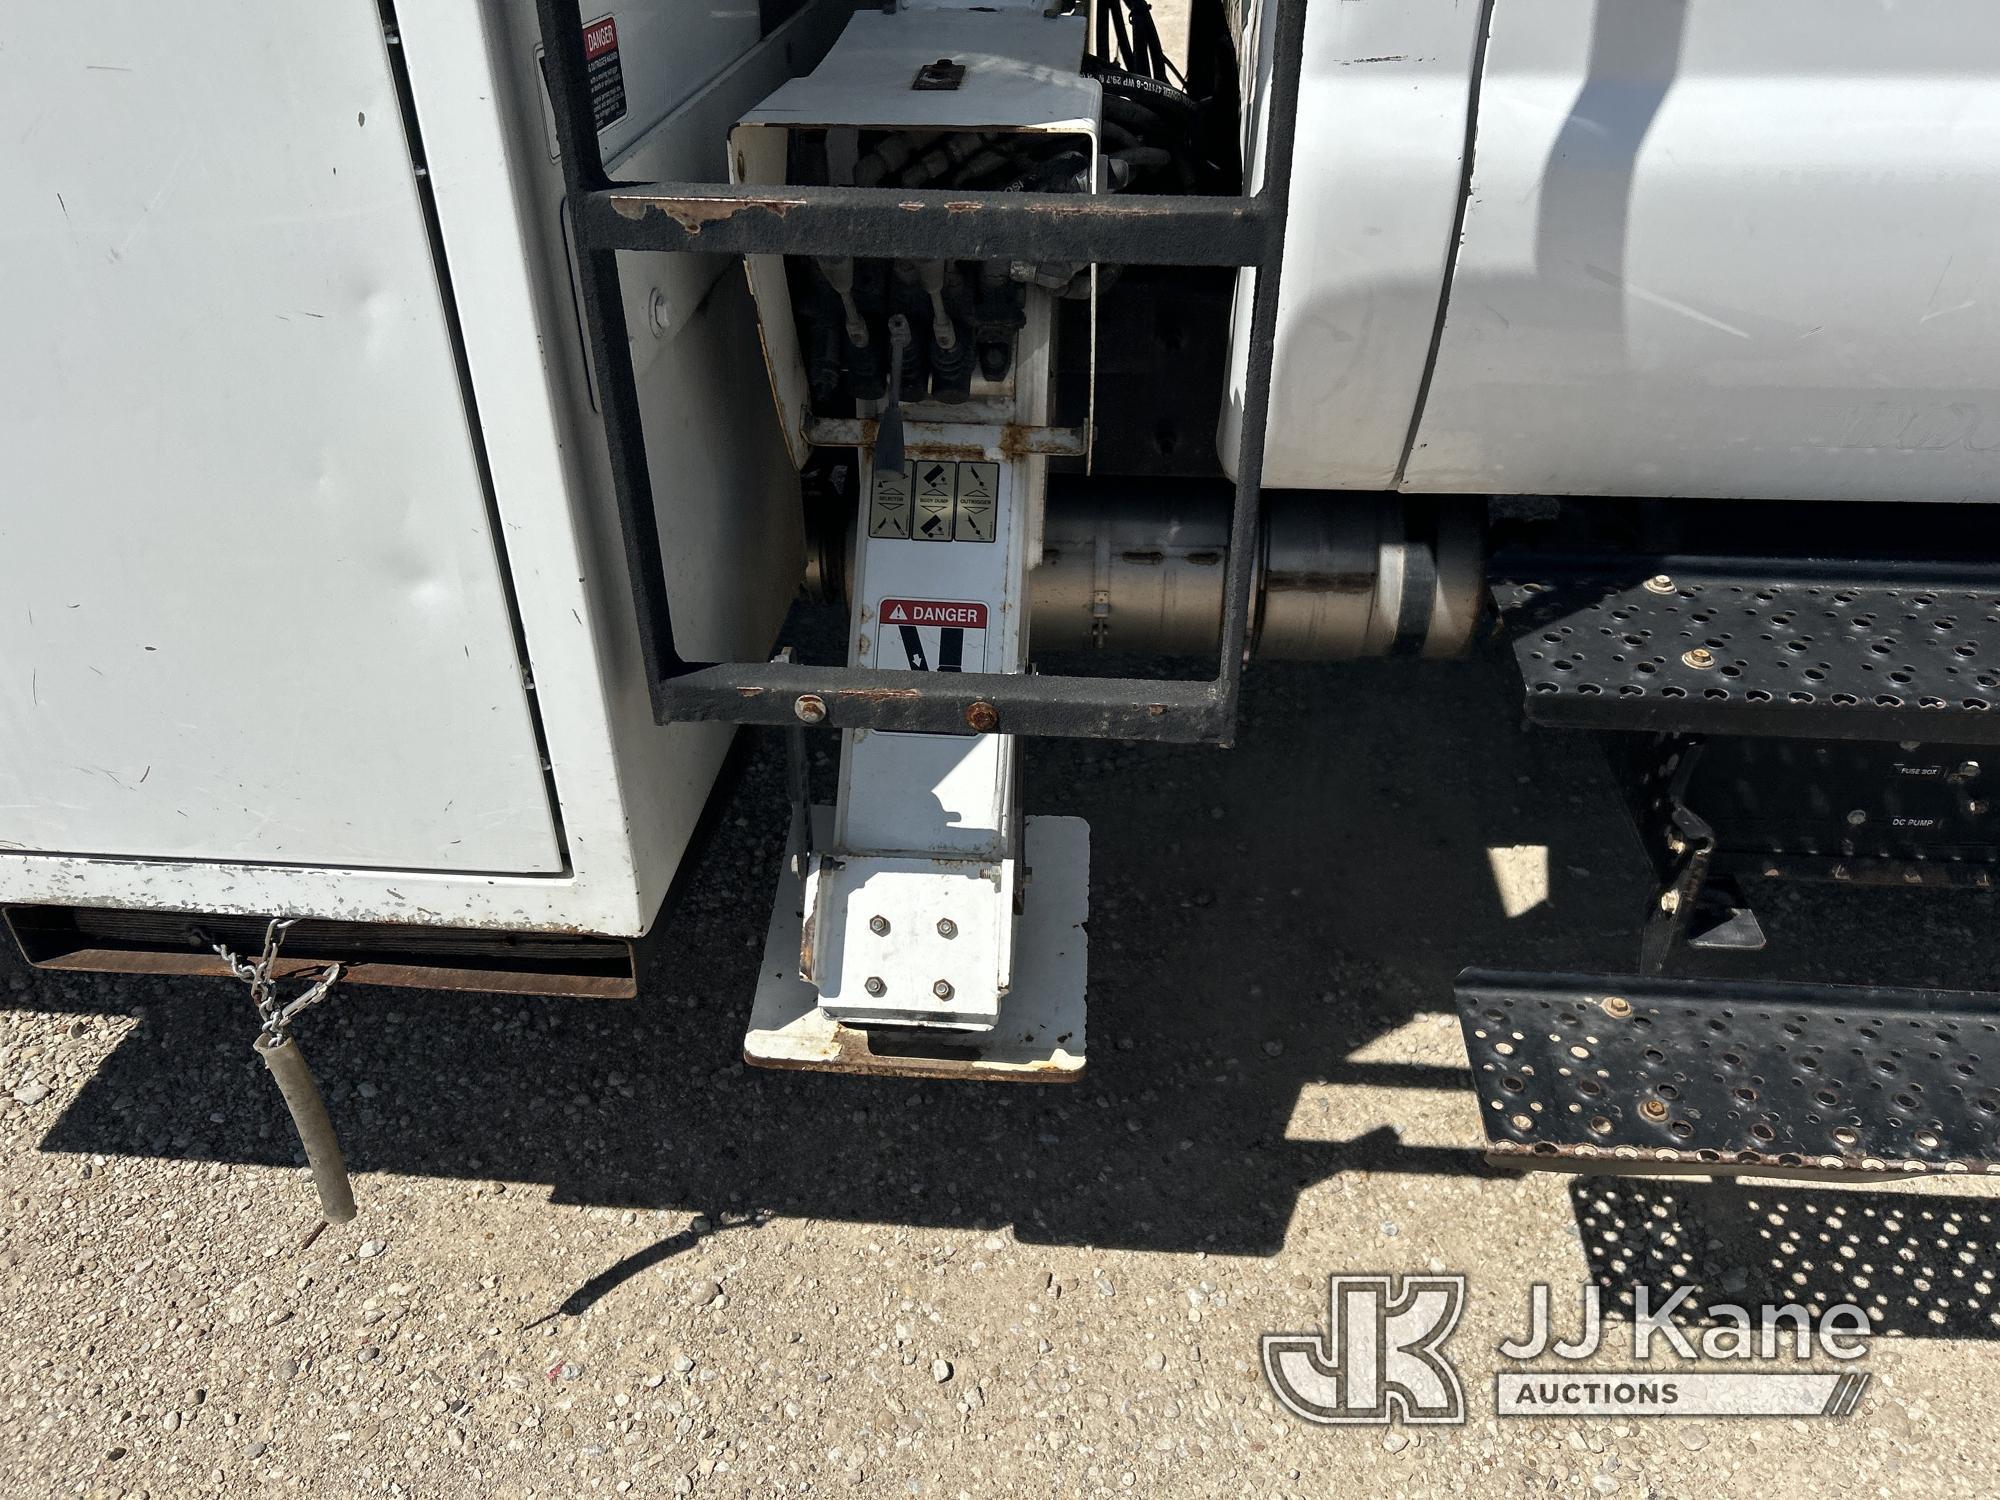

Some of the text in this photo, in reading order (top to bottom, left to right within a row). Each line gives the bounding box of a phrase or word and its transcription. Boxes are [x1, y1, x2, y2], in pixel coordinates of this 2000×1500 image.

[588, 25, 614, 52] DANGER
[1121, 76, 1135, 88] WP
[913, 606, 978, 623] DANGER
[1901, 767, 1920, 775] FUSE
[1892, 818, 1934, 827] DC PUMP
